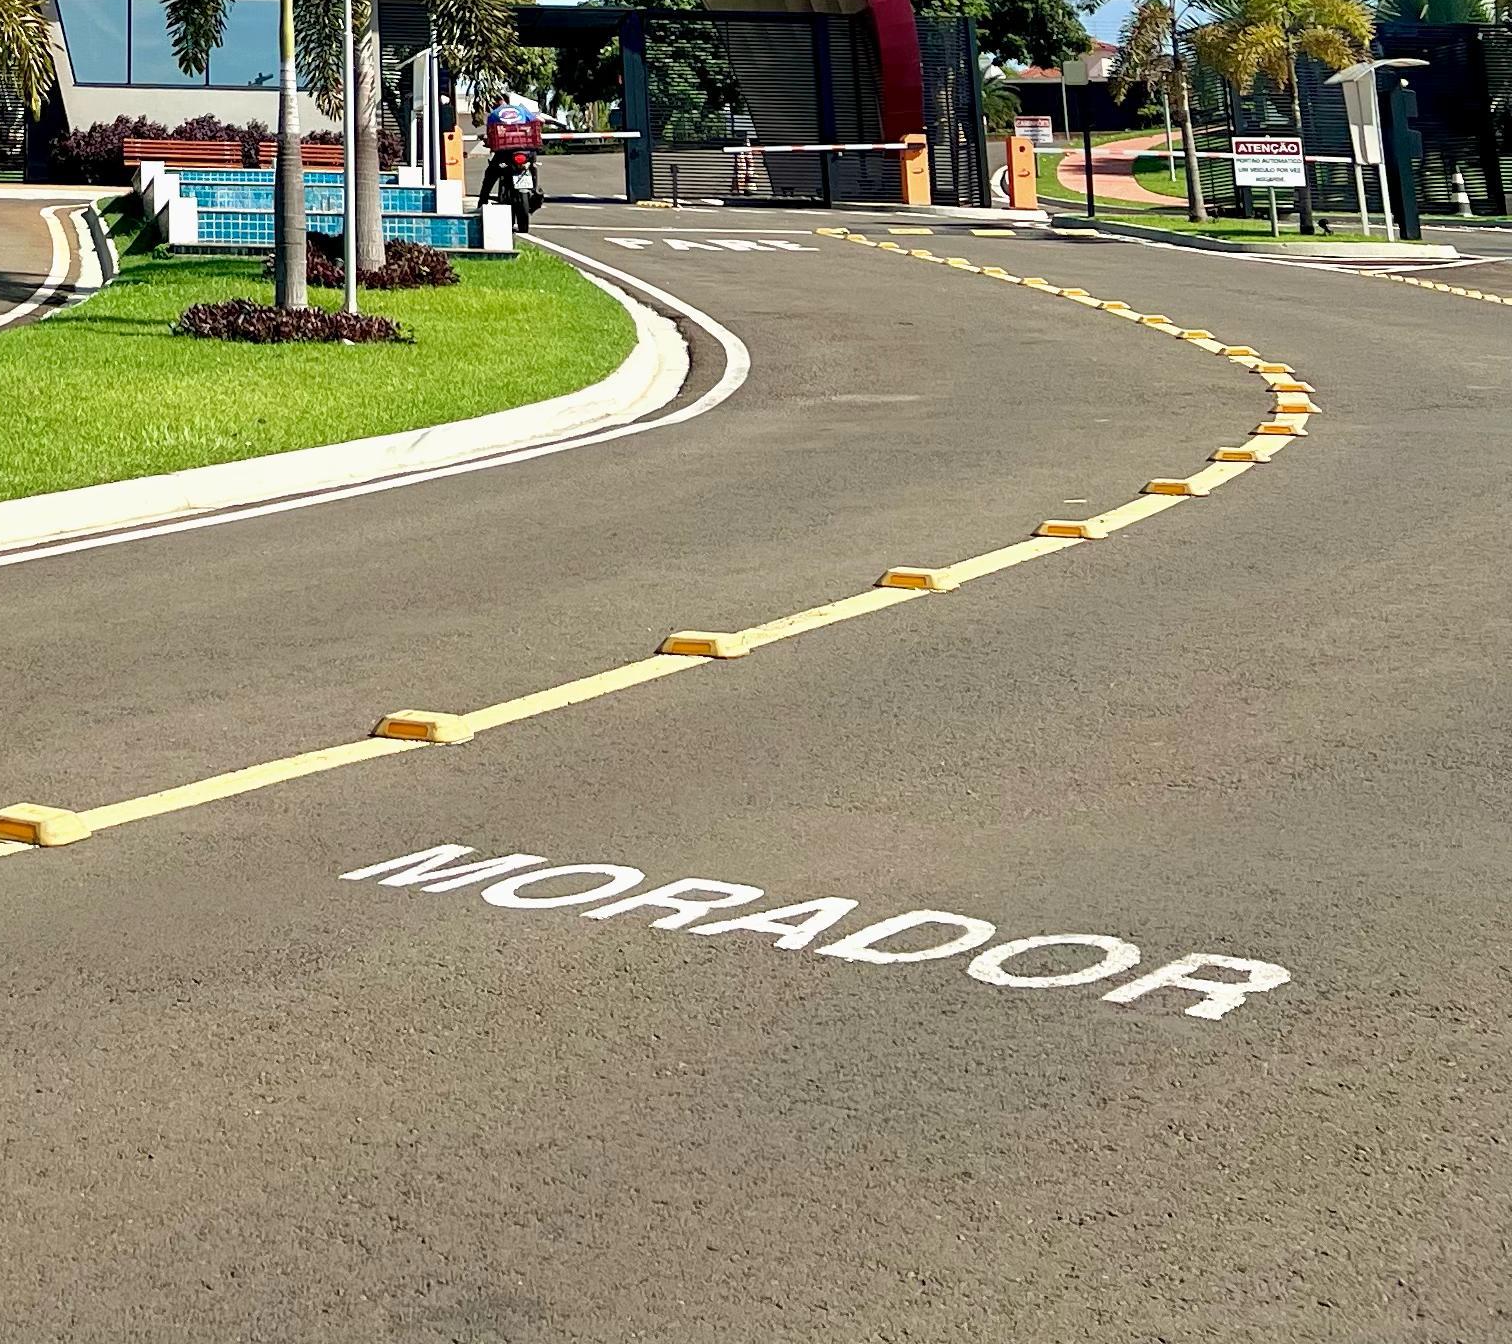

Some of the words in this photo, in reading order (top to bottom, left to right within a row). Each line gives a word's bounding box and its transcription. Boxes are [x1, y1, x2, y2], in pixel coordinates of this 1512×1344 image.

[1238, 142, 1298, 154] ATENÇÃO
[604, 237, 820, 251] PARE
[338, 843, 1292, 1021] MORADOR
